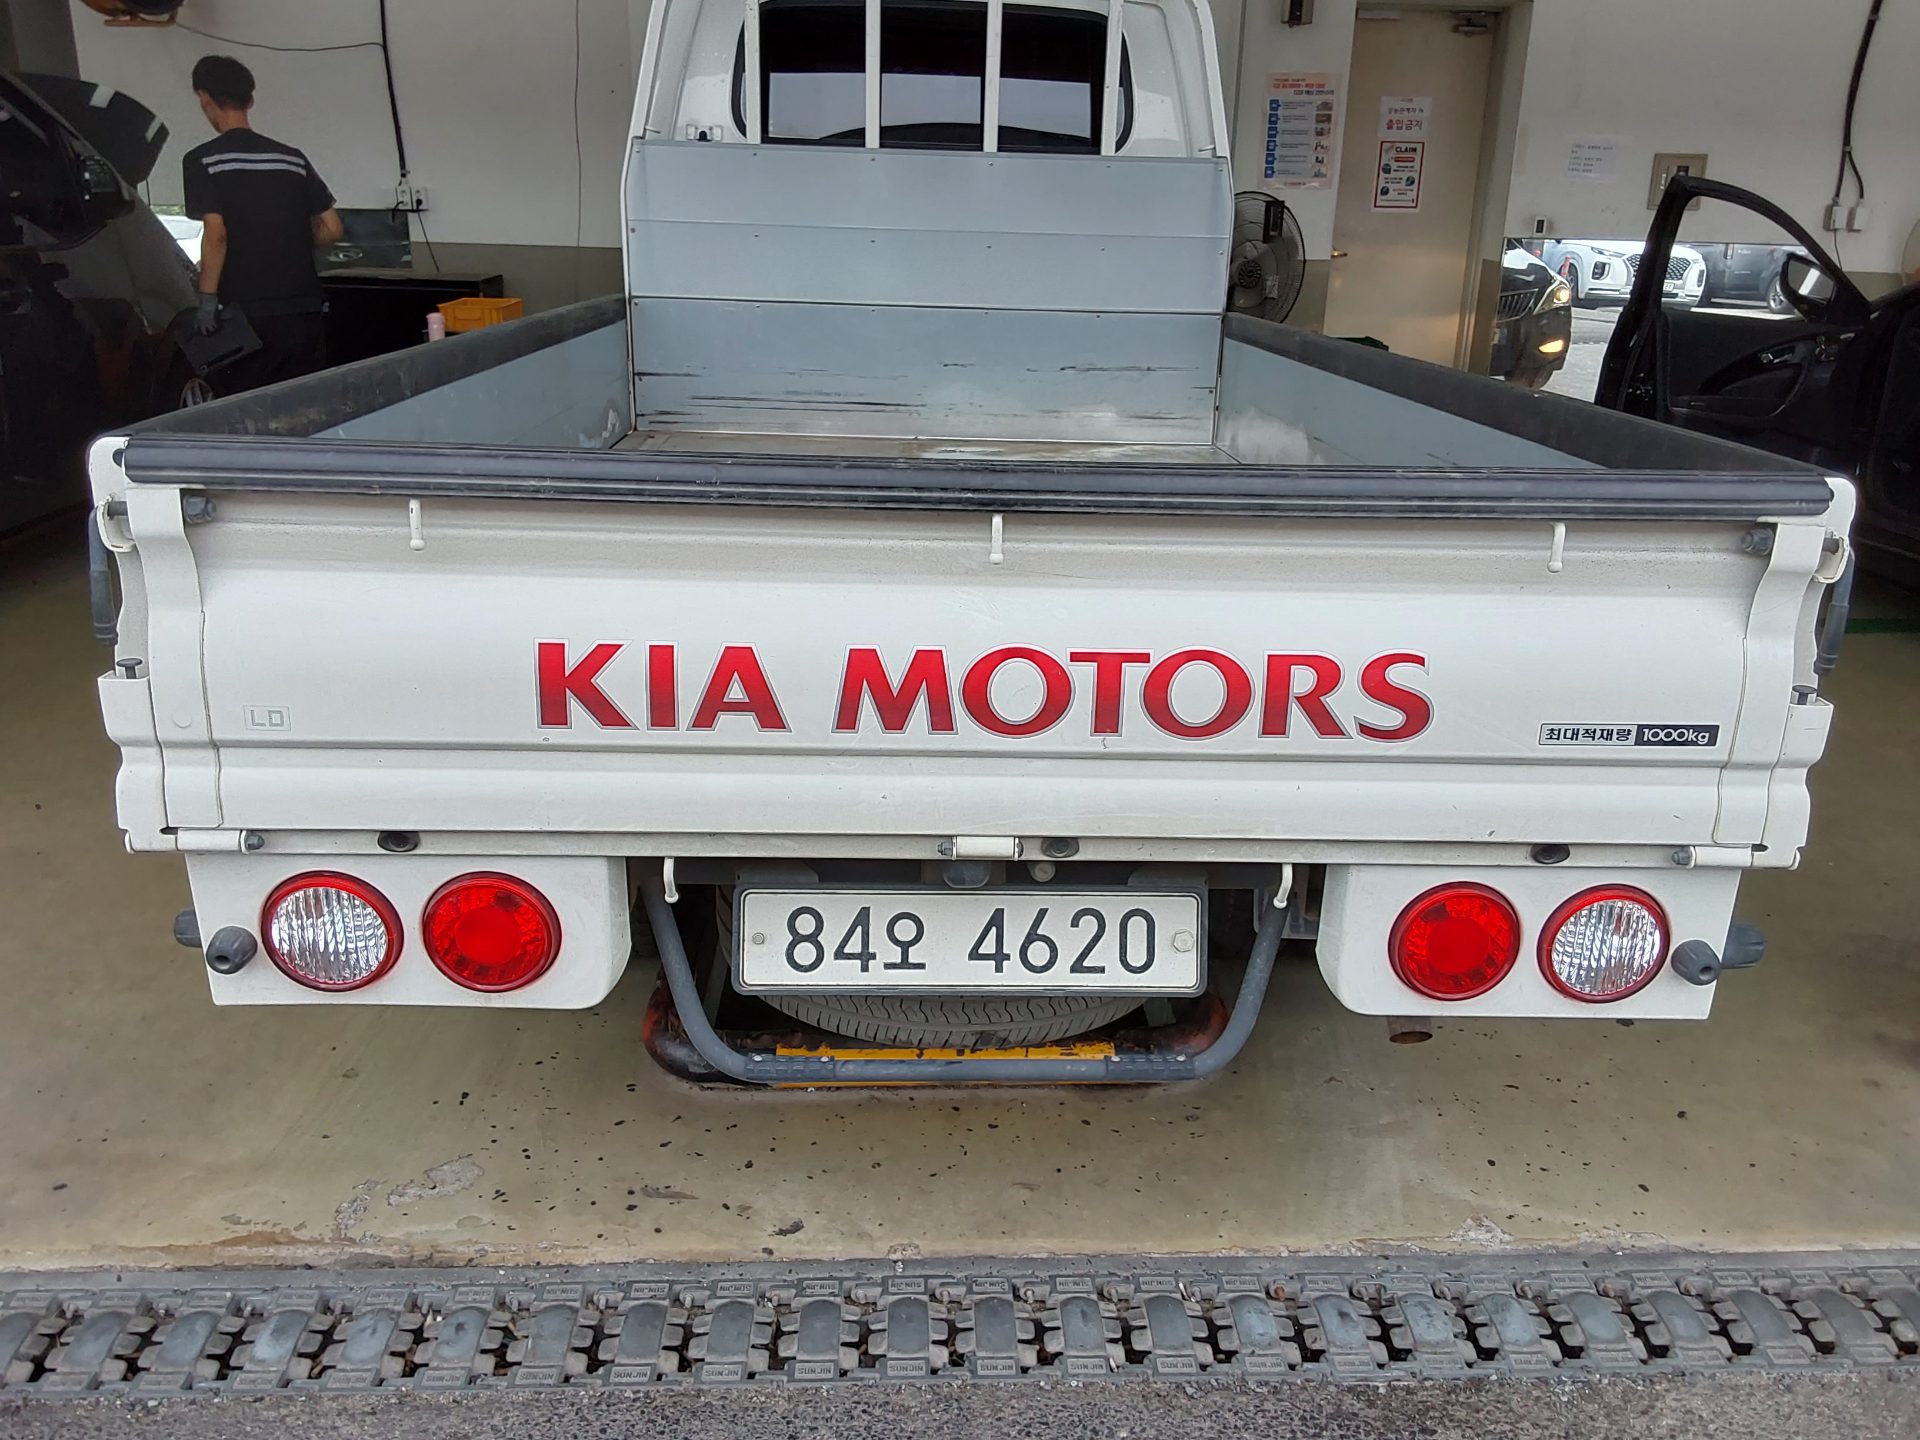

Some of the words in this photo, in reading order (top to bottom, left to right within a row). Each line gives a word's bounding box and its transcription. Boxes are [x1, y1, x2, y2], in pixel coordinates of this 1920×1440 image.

[1386, 118, 1423, 131] 출입금지
[533, 636, 794, 734] KIA
[830, 643, 1436, 742] MOTORS
[1544, 727, 1633, 742] 최대적재량
[1642, 728, 1710, 745] 1000kg
[784, 905, 926, 973] 84오
[966, 906, 1156, 975] 4620
